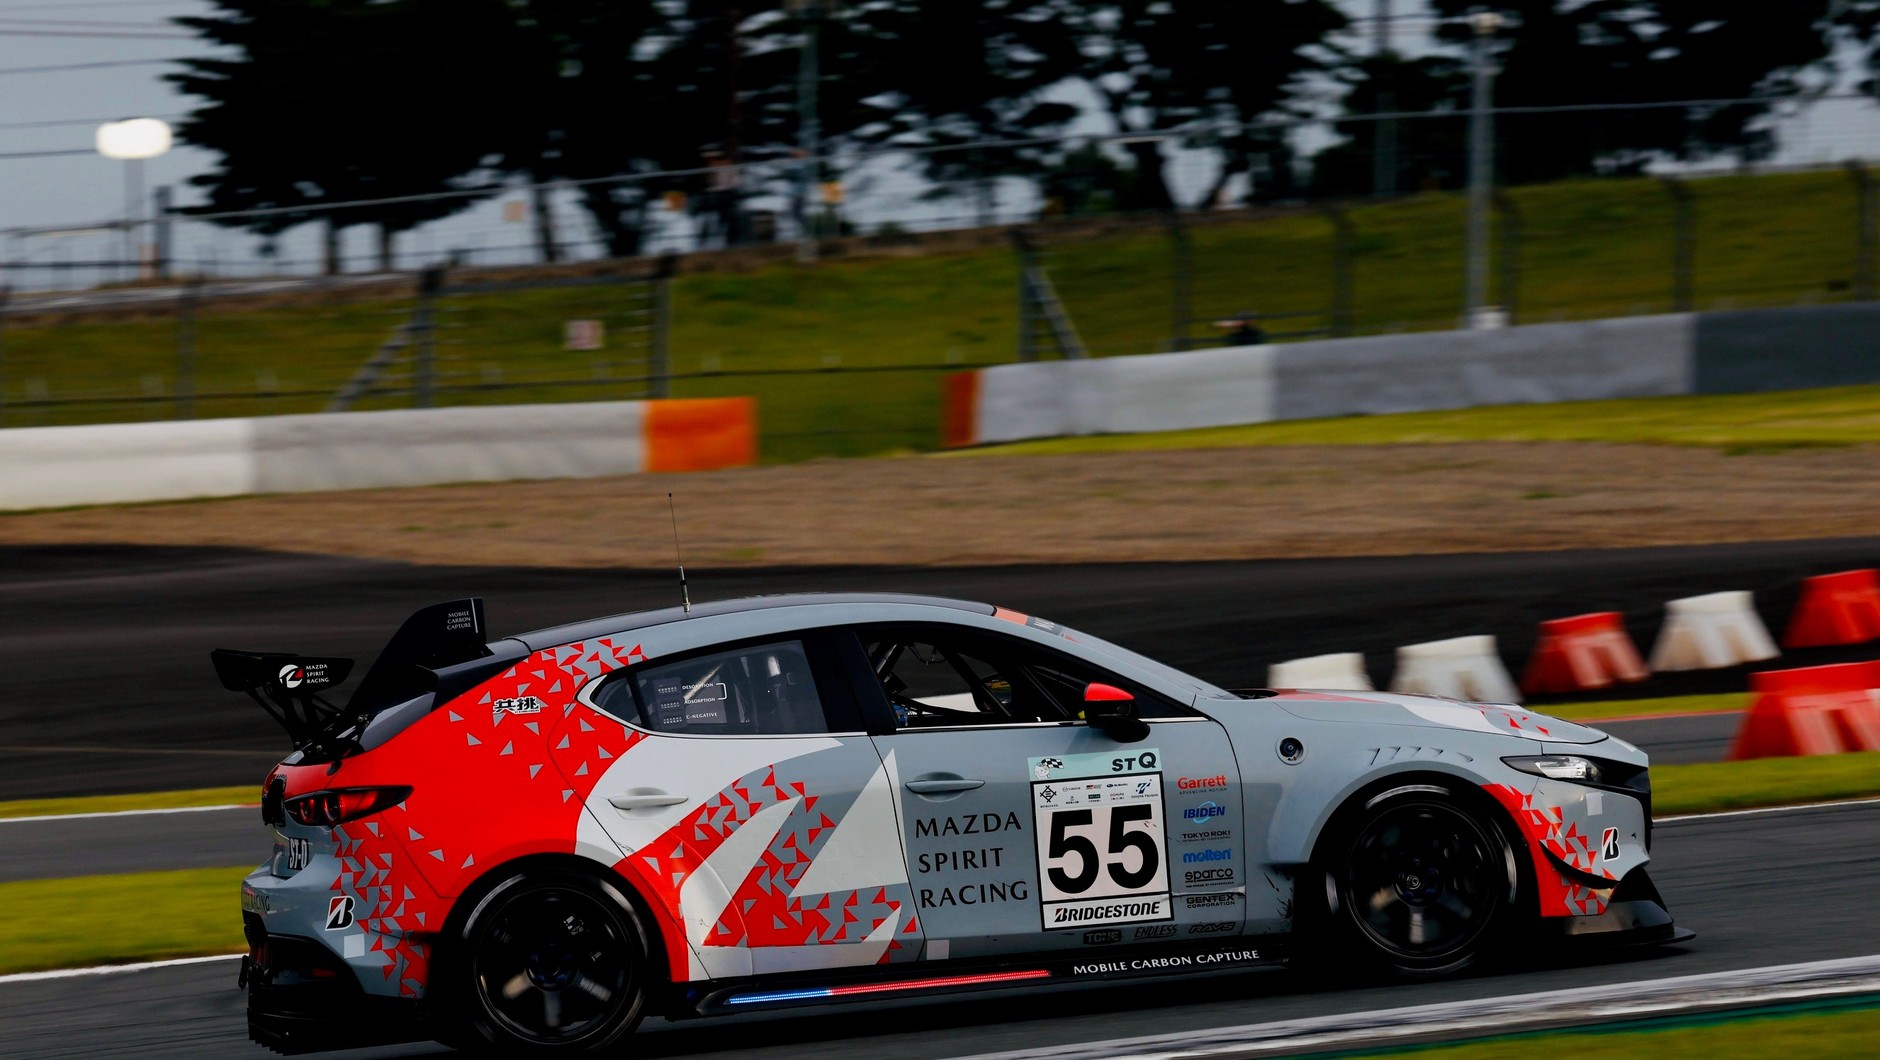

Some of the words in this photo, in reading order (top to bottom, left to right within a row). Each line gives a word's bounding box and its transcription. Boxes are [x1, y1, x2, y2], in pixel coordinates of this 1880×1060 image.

[1177, 775, 1226, 789] Garrett
[1183, 806, 1226, 819] IBIDEN
[915, 812, 1022, 838] MAZDA
[1182, 831, 1210, 839] TOKYO
[1047, 803, 1159, 894] 55
[1183, 849, 1232, 863] molten
[918, 847, 1004, 874] SPIRIT
[1184, 868, 1234, 883] sparco
[920, 881, 1028, 909] RACING
[1186, 893, 1235, 904] GENTEX
[1187, 900, 1236, 908] CORPORATION
[1054, 902, 1161, 922] BRIDGESTONE
[1134, 924, 1179, 939] ENDLESS
[1188, 922, 1236, 934] RAYS
[1073, 961, 1128, 975] MOBILE
[1131, 956, 1193, 969] CARBON
[1196, 950, 1260, 964] CAPTURE
